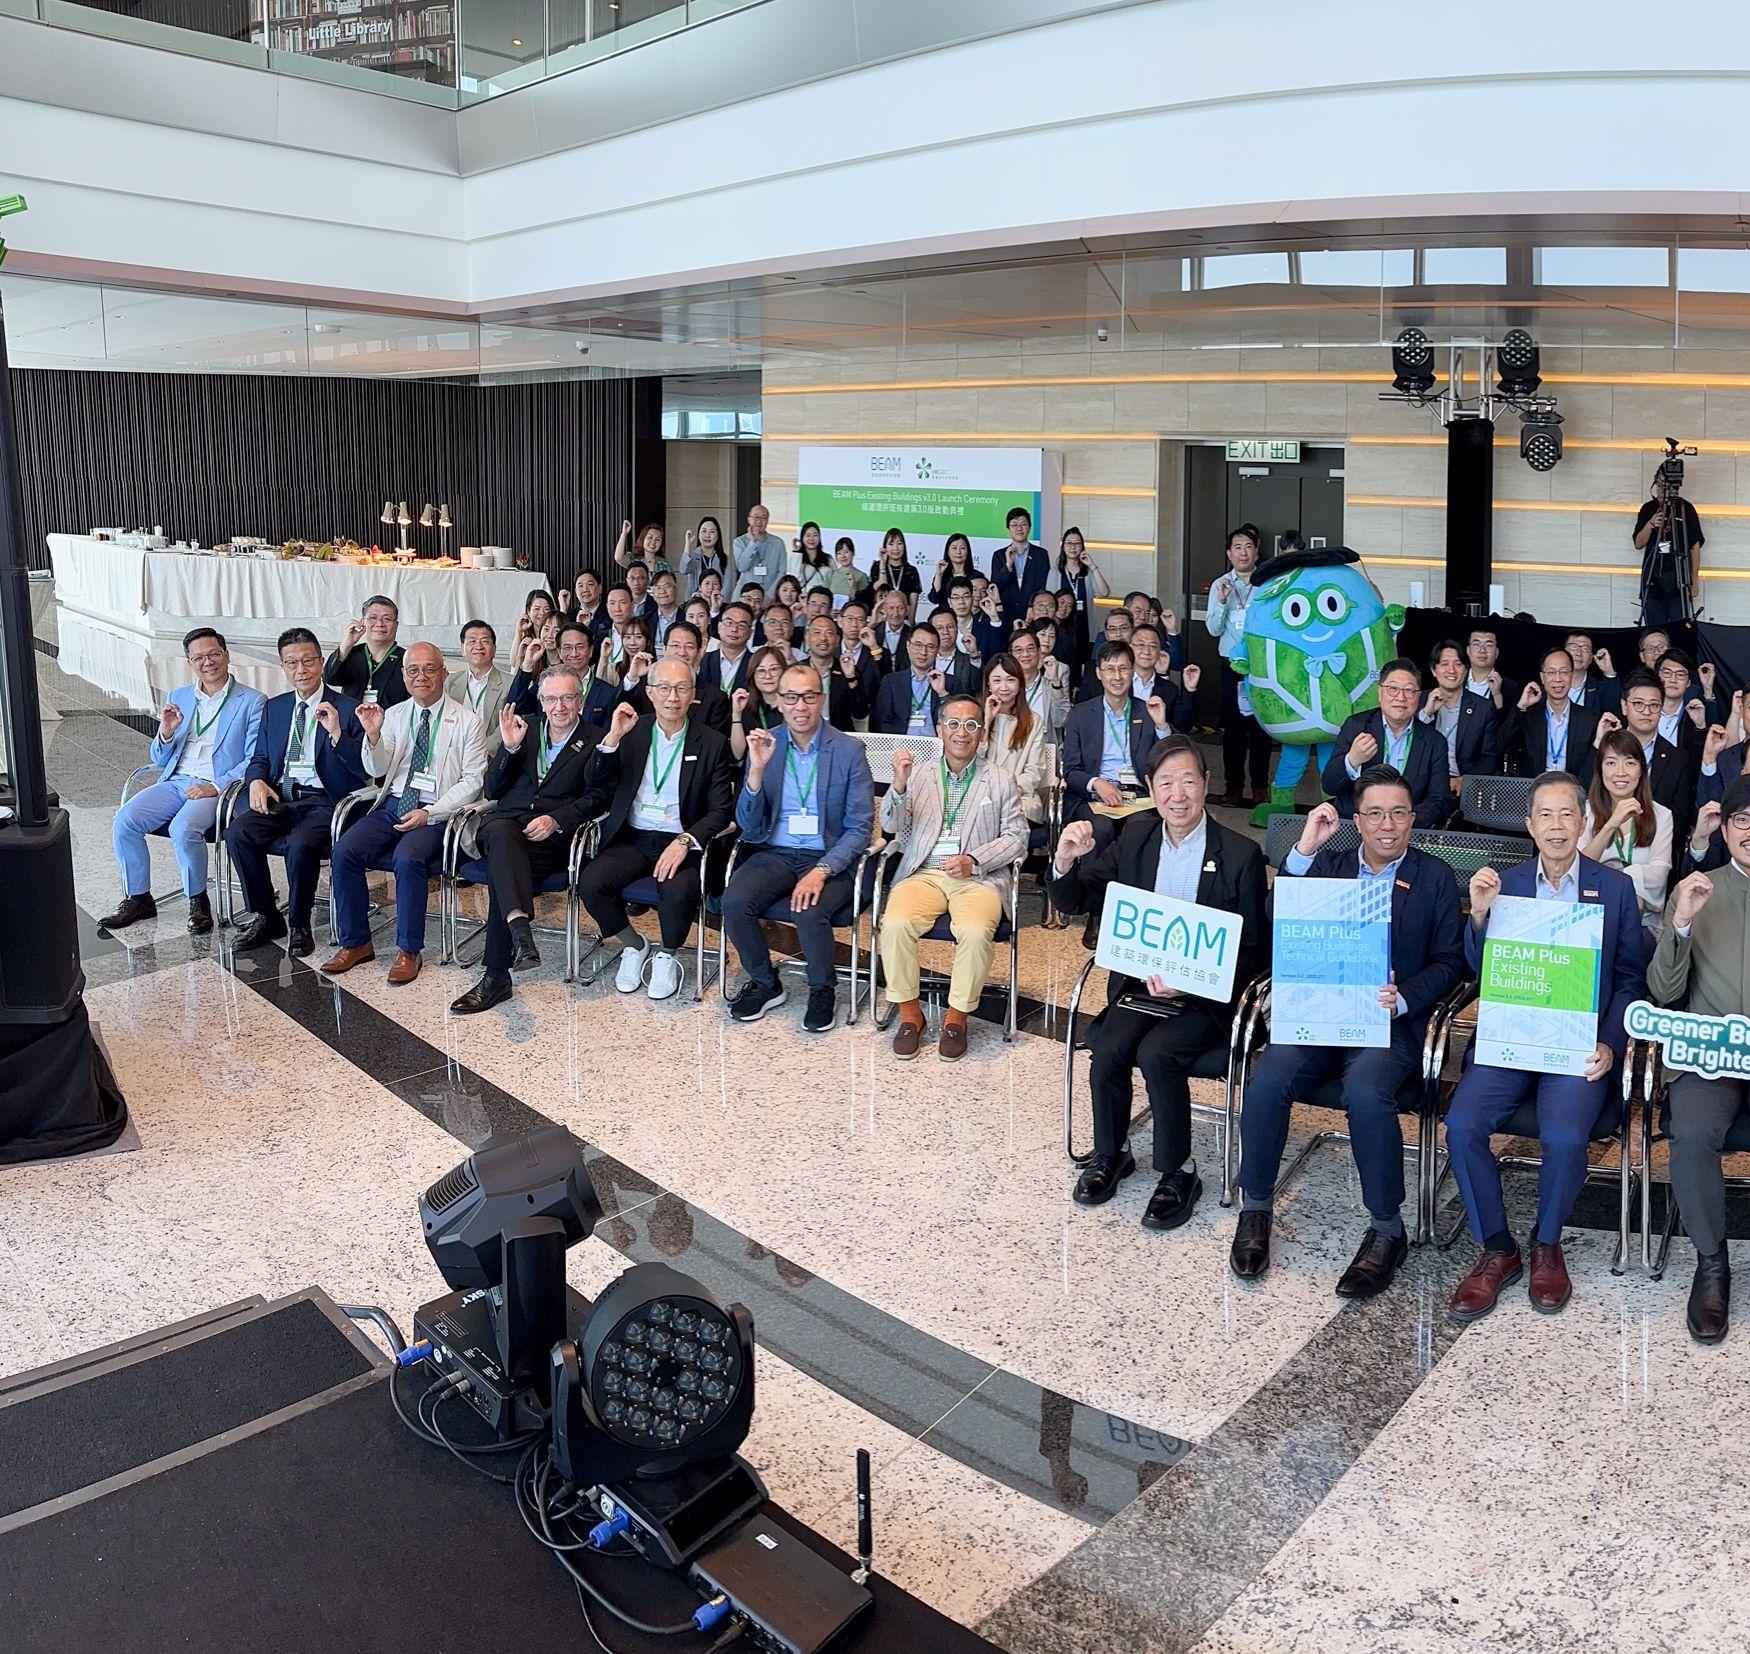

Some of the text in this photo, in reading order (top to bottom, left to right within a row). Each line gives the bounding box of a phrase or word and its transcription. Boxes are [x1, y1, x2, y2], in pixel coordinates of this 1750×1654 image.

[309, 21, 391, 41] Little Library
[1228, 441, 1298, 459] EXIT 出口
[871, 457, 901, 471] BEAM
[832, 489, 999, 506] BEAM Plus Existing Buildings v3.0 Launch Ceremony
[1113, 900, 1227, 966] BEAM
[1281, 924, 1361, 940] BEAM Plus
[1281, 939, 1370, 952] Existing Buildings
[1492, 944, 1571, 965] BEAM Plus
[1110, 944, 1220, 985] 建築環保評估協會
[1491, 958, 1545, 980] Existing
[1490, 973, 1552, 995] Buildings
[1340, 1029, 1366, 1038] BEAM
[1631, 1009, 1724, 1041] Greener
[1544, 1053, 1570, 1064] BEAM
